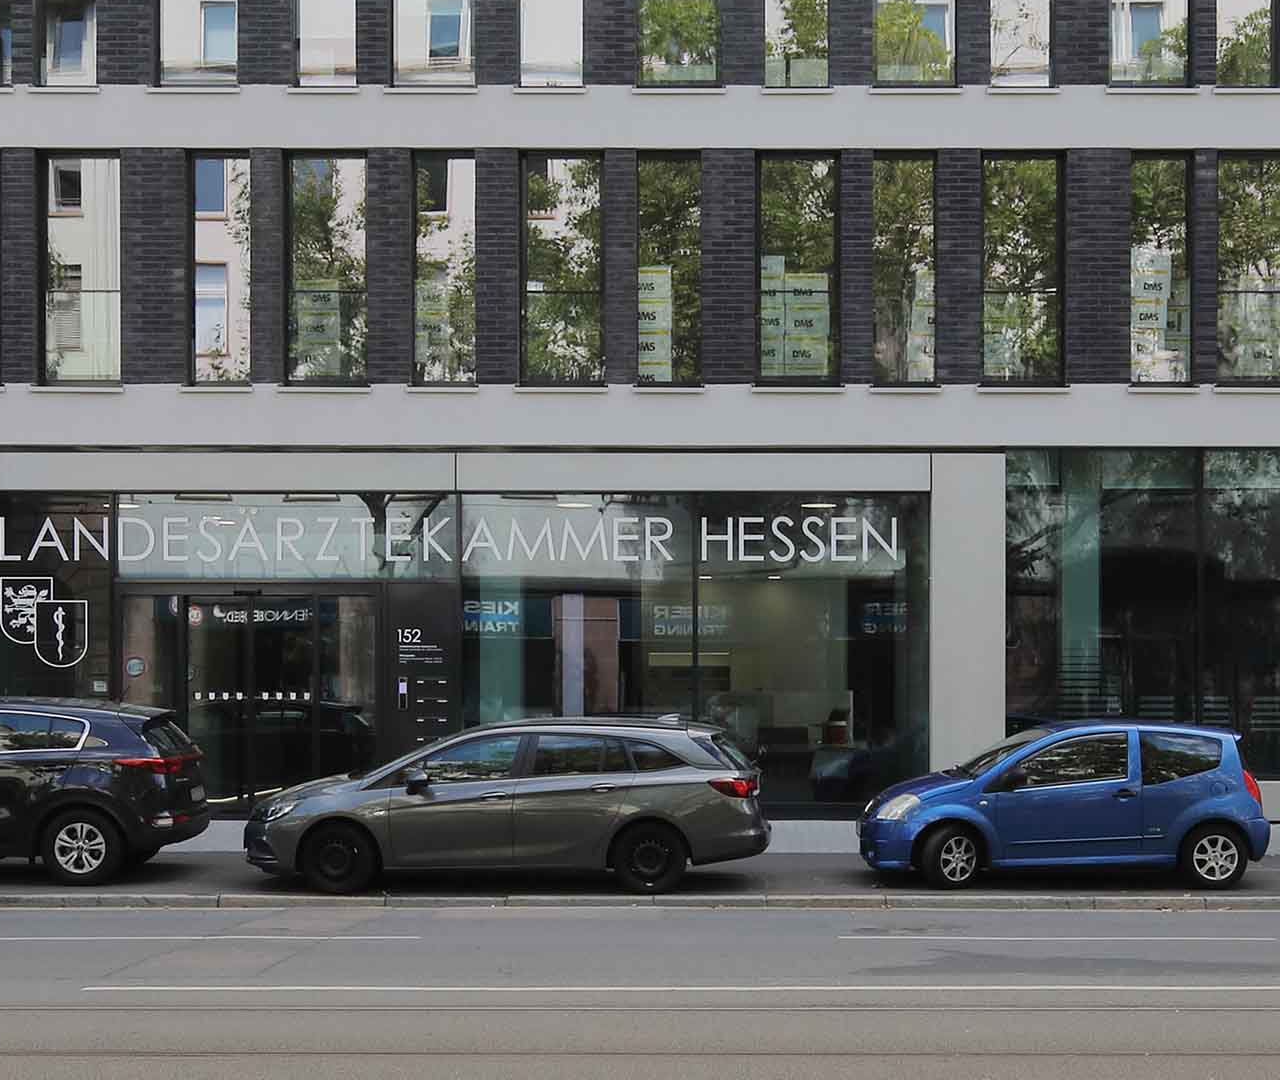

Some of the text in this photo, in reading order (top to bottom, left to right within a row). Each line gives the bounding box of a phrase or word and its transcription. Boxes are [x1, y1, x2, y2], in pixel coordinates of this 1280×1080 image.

[639, 282, 655, 291] MS
[1144, 283, 1163, 291] DMS
[793, 288, 813, 297] DMS
[639, 311, 656, 321] MS
[1139, 313, 1159, 321] DMS
[794, 319, 814, 328] DMS
[639, 341, 656, 351] MS
[792, 350, 812, 358] DMS
[700, 515, 899, 562] HESSEN
[397, 628, 422, 643] 152
